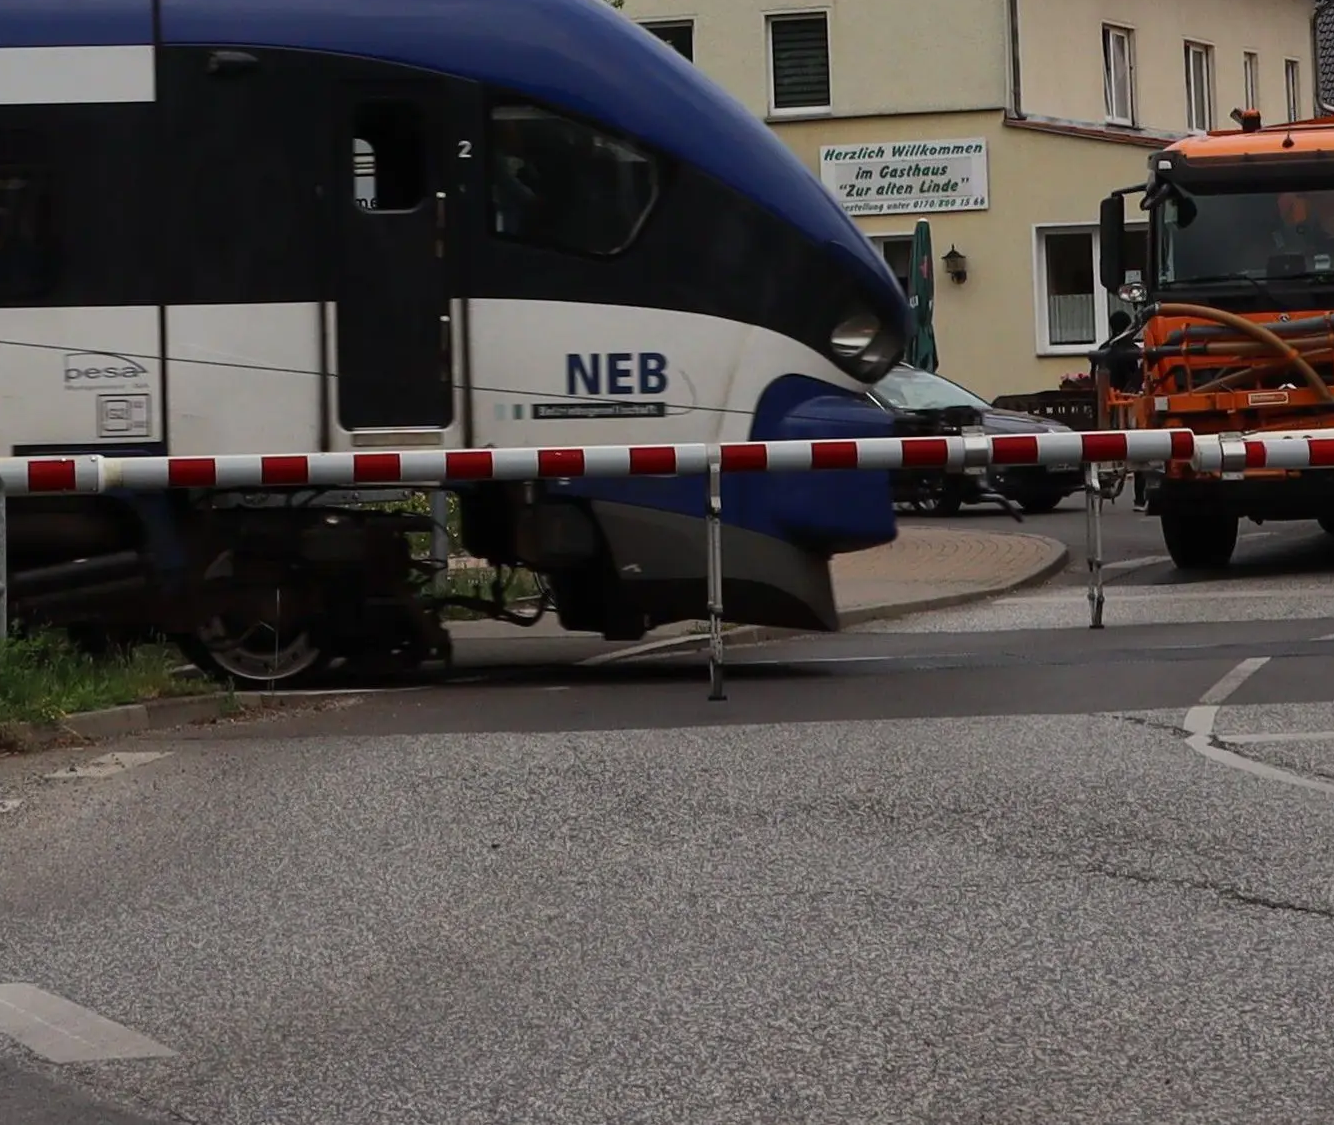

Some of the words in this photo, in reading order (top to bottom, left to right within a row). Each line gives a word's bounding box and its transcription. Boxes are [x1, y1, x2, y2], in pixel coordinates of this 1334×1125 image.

[458, 140, 473, 158] 2
[824, 147, 885, 161] Herzlich
[892, 143, 983, 158] Willkommen
[855, 167, 873, 180] im
[879, 164, 948, 179] Gasthaus
[876, 181, 913, 196] alten
[65, 366, 139, 382] pesa
[566, 352, 669, 395] NEB
